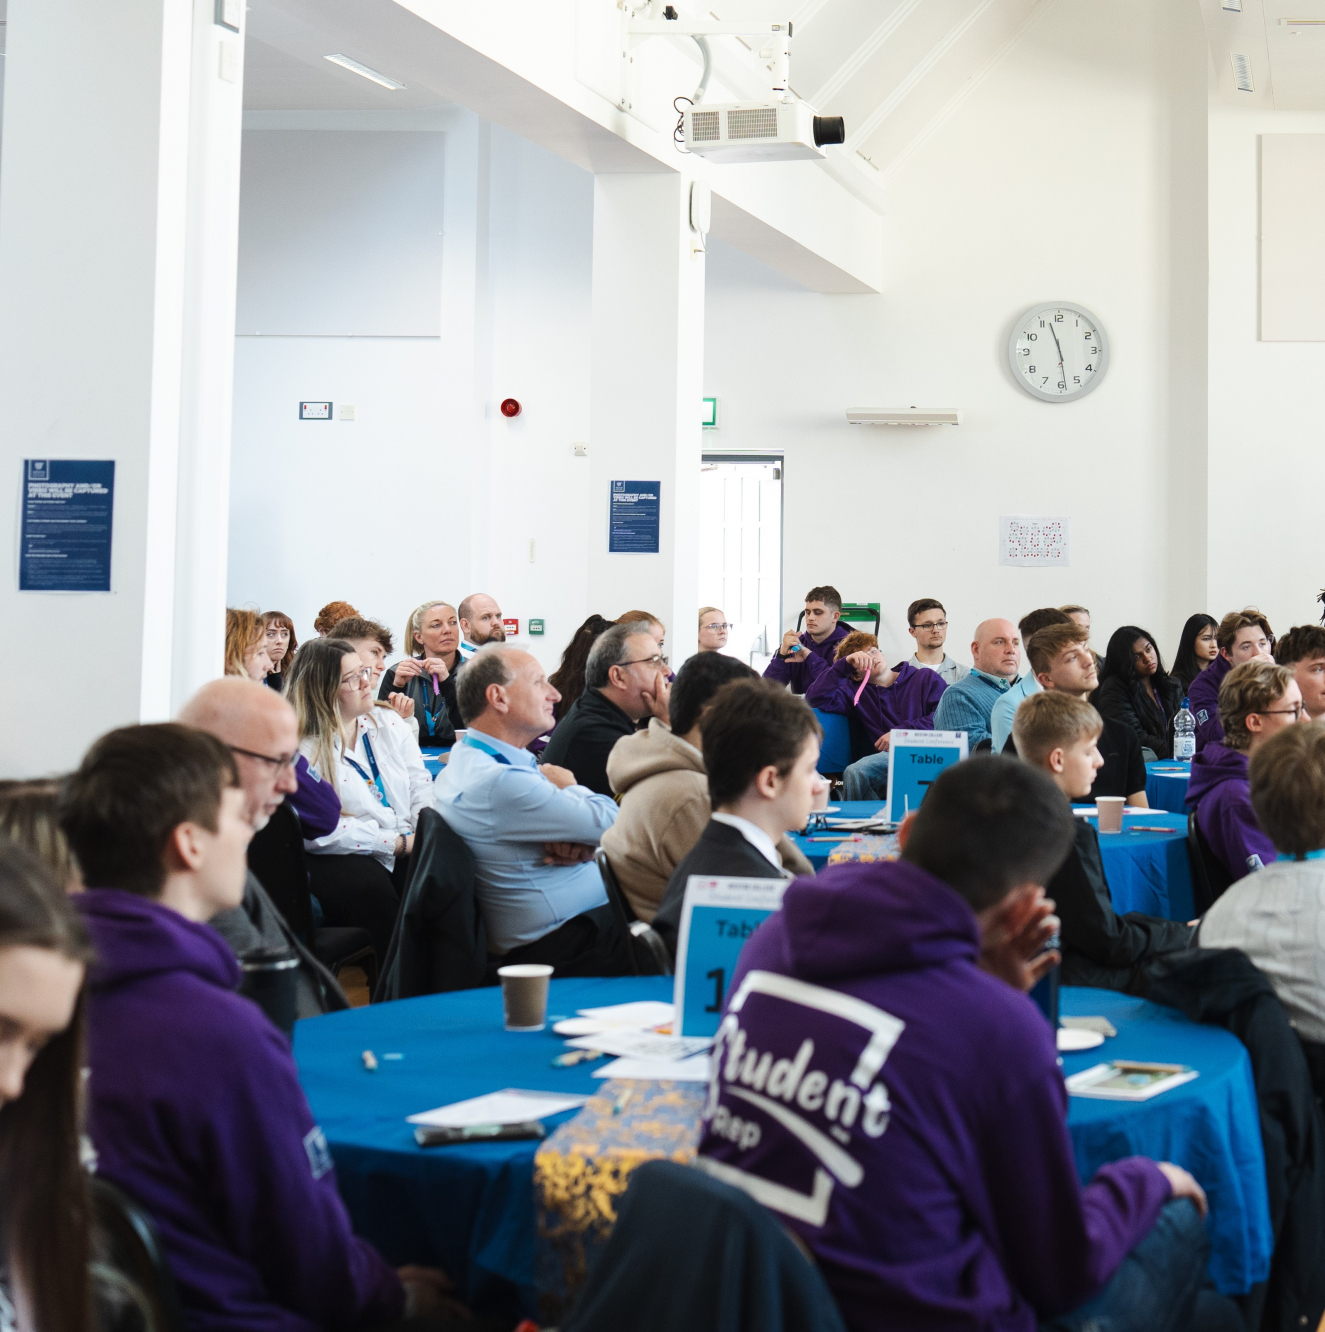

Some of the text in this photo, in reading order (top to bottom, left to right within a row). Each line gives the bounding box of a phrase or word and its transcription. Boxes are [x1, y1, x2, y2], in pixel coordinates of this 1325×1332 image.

[1054, 314, 1064, 323] 12
[1027, 333, 1037, 341] 10
[1084, 332, 1091, 340] 2
[1022, 348, 1030, 357] 9
[1091, 346, 1097, 354] 3
[1029, 365, 1036, 373] 8
[1085, 364, 1092, 372] 4
[1042, 376, 1049, 384] 7
[1073, 376, 1080, 384] 5
[1057, 381, 1064, 389] 6
[909, 753, 944, 765] Table
[715, 918, 760, 939] Tab
[704, 966, 724, 1013] 1
[711, 1106, 762, 1151] Rep
